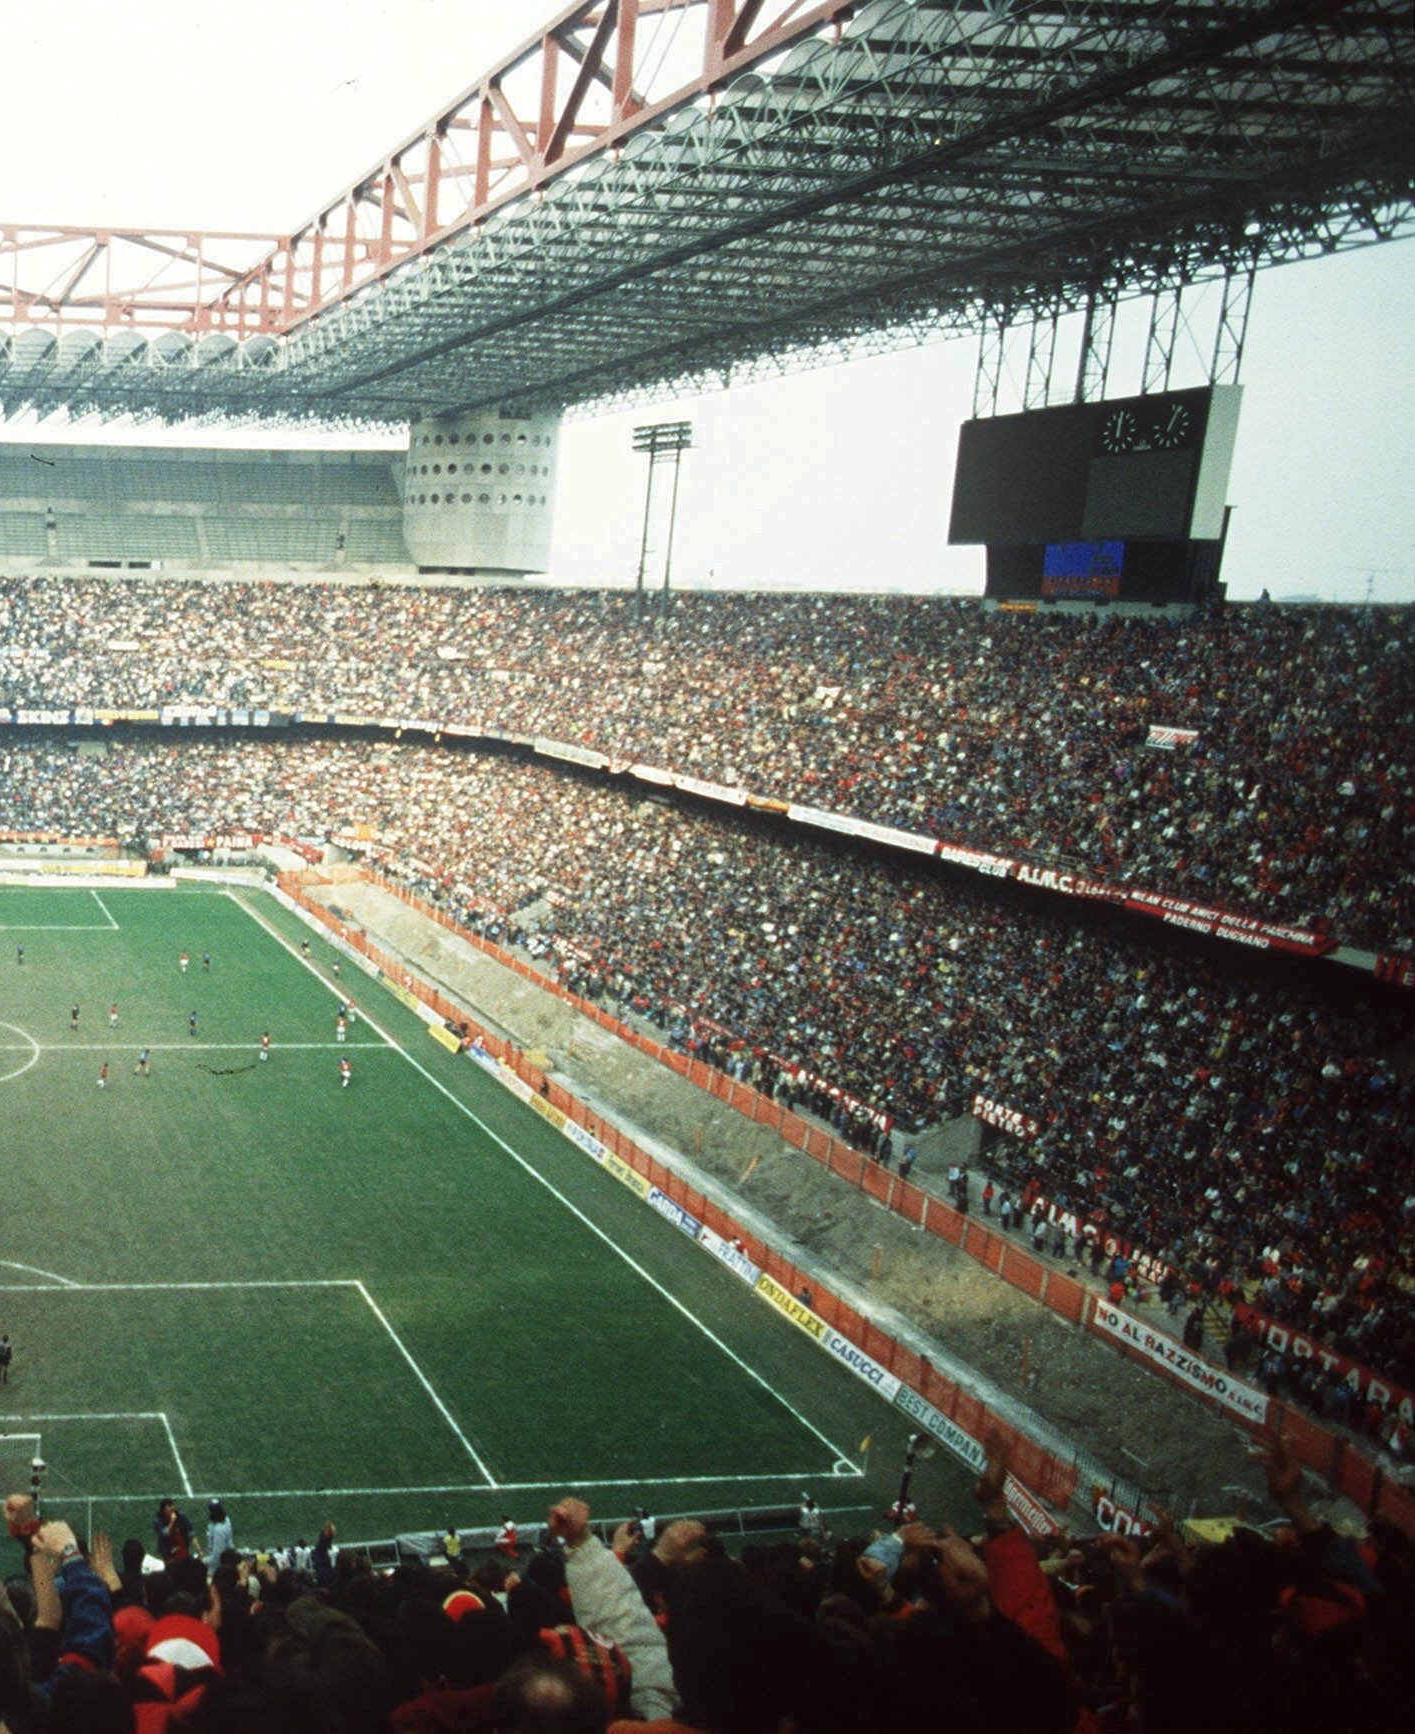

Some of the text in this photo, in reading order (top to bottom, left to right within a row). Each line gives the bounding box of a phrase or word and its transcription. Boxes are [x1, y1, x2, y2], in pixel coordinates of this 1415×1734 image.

[1161, 898, 1190, 913] CLUB
[1220, 914, 1258, 931] DELLA
[1162, 912, 1212, 935] PADERNO
[758, 1275, 826, 1339] ONDAFLEX
[829, 1336, 885, 1387] CASUCCI
[1097, 1305, 1120, 1328] NO
[1122, 1322, 1141, 1343] AL
[1143, 1334, 1228, 1397] RAZZISMO
[896, 1387, 929, 1420] BEST
